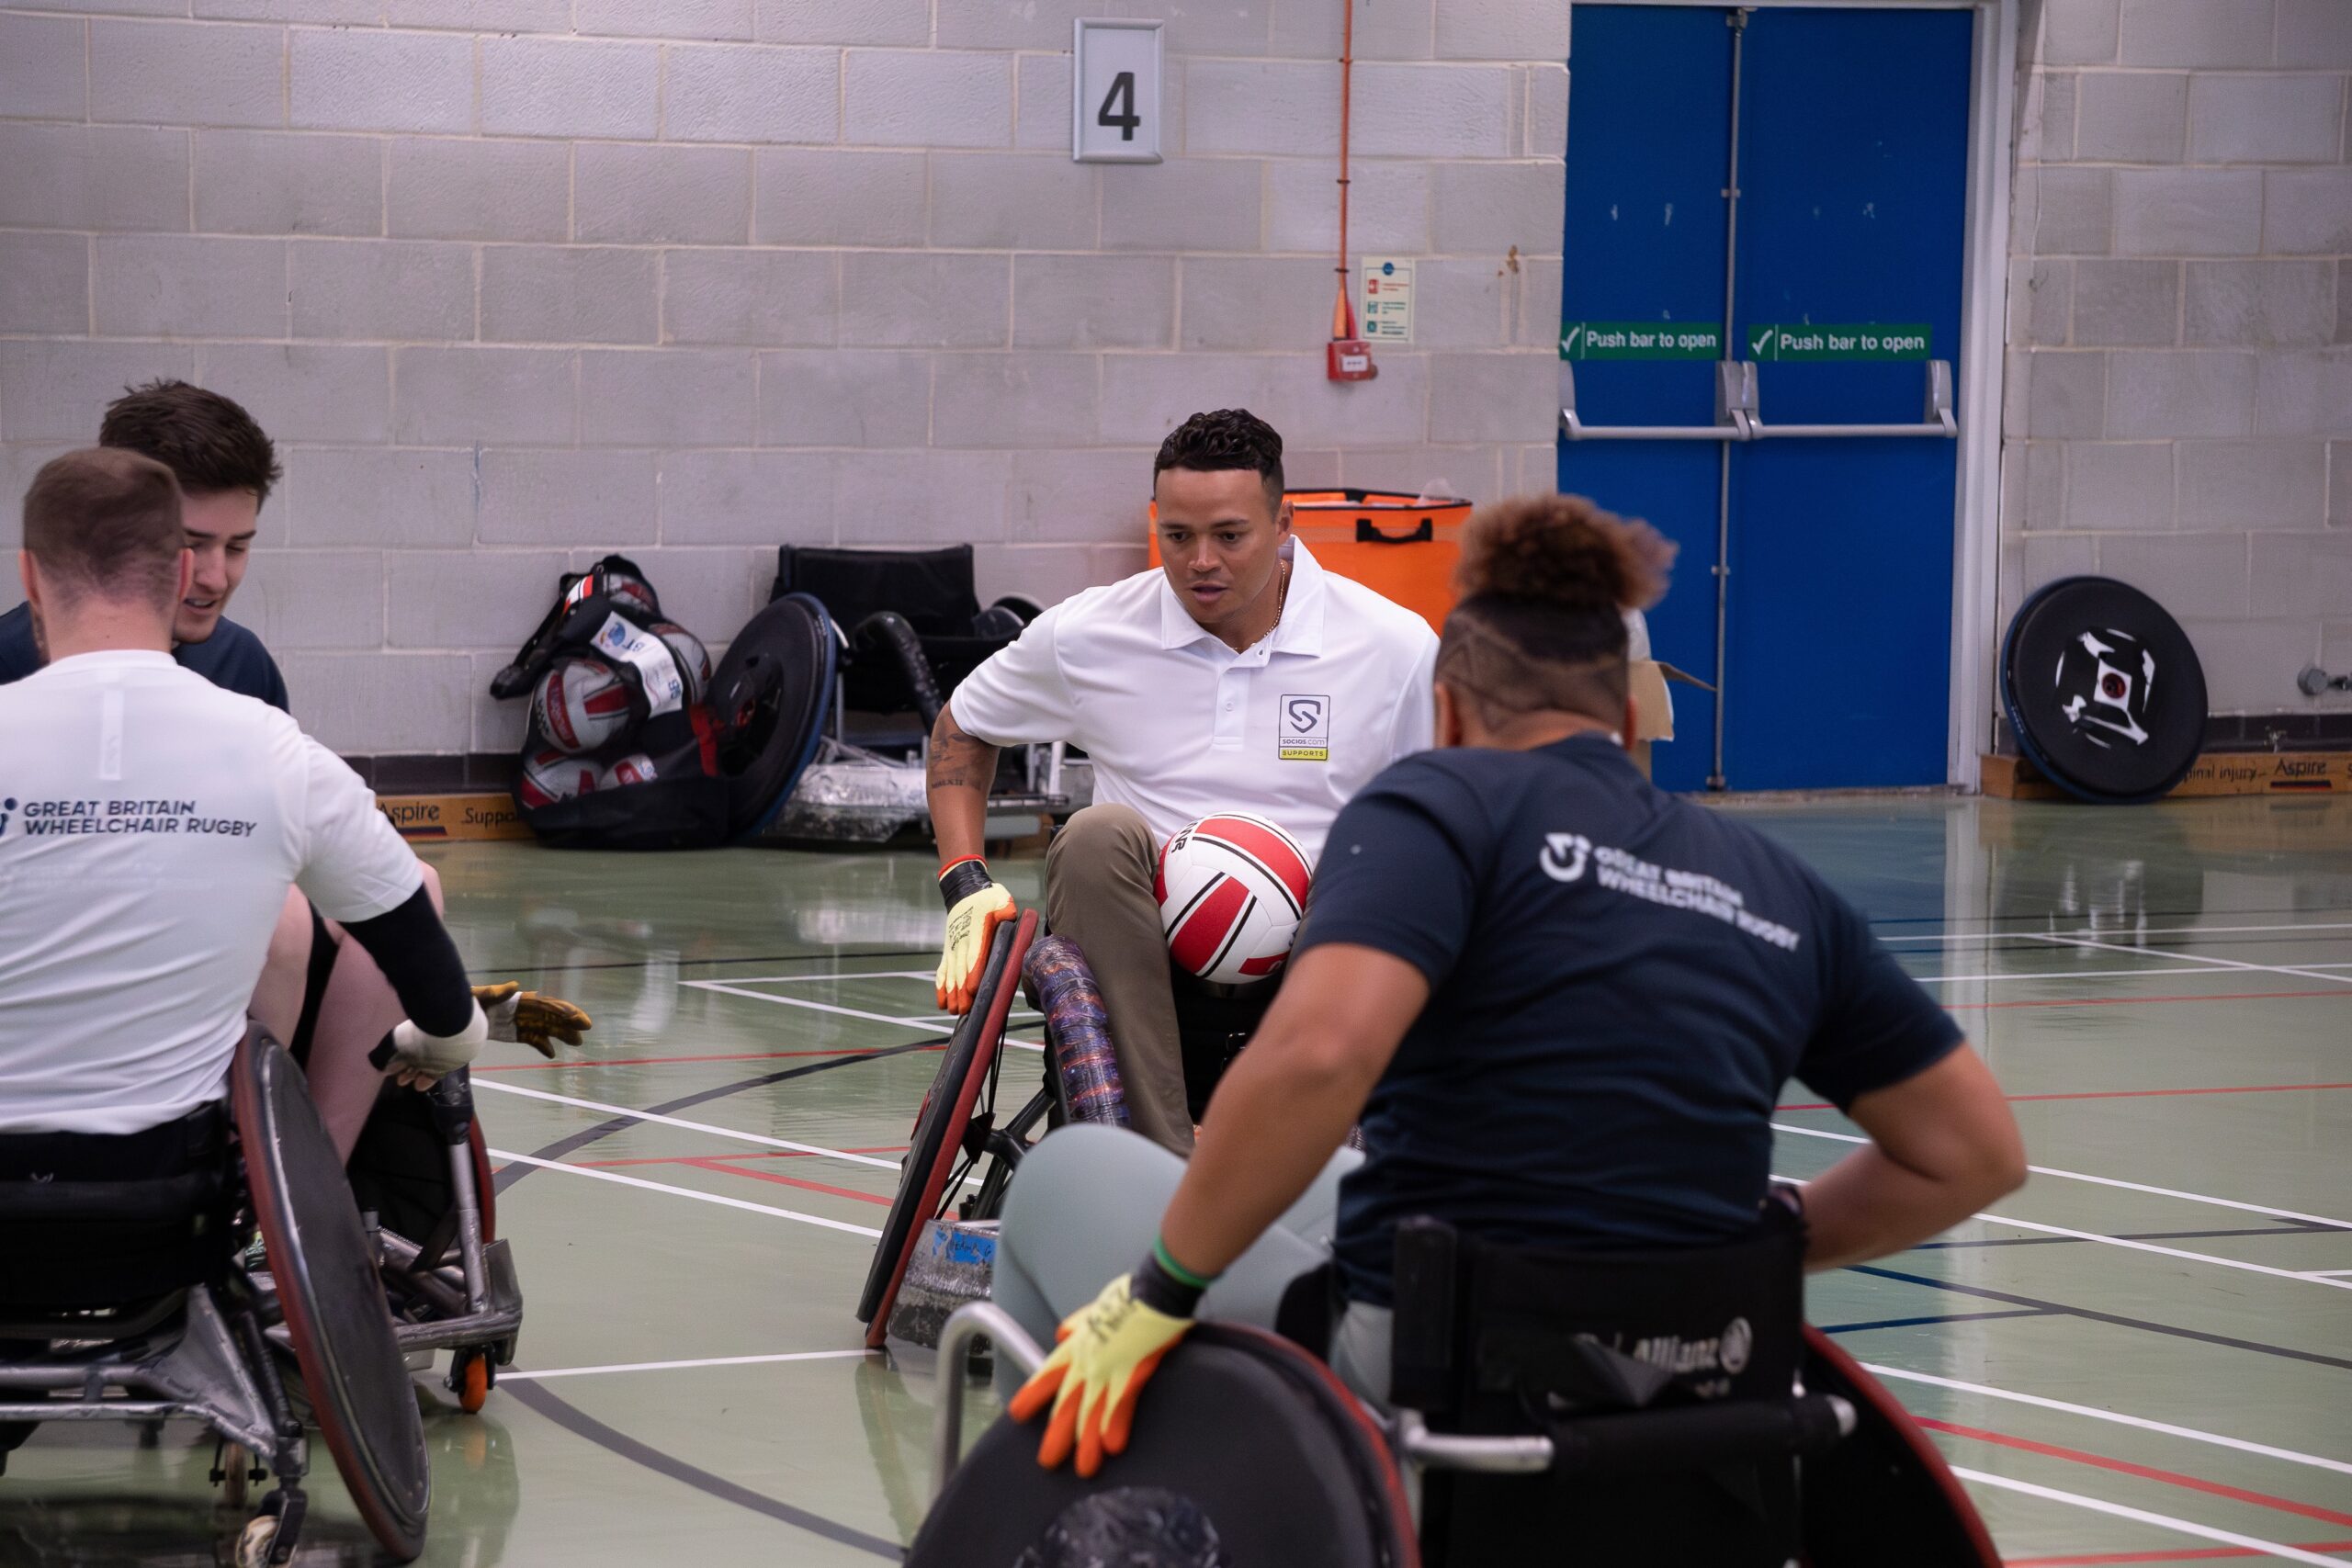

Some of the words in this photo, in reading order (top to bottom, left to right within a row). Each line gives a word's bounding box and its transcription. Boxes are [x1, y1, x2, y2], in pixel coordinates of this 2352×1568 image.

[1097, 71, 1141, 141] 4
[1586, 331, 1625, 349] Push
[1629, 331, 1656, 348] bar
[1658, 332, 1674, 349] to
[1678, 333, 1716, 352] open
[1780, 333, 1823, 351] Push
[1828, 333, 1856, 351] bar
[1860, 333, 1877, 351] to
[1882, 335, 1925, 354] open
[2183, 763, 2215, 784] pinal
[2274, 759, 2327, 777] Aspire
[23, 800, 101, 818] GREAT
[107, 800, 196, 816] BRITAIN
[379, 800, 440, 825] Aspire
[464, 807, 515, 829] Suppo
[24, 817, 180, 836] WHEELCHAIR
[186, 818, 257, 838] RUGBY
